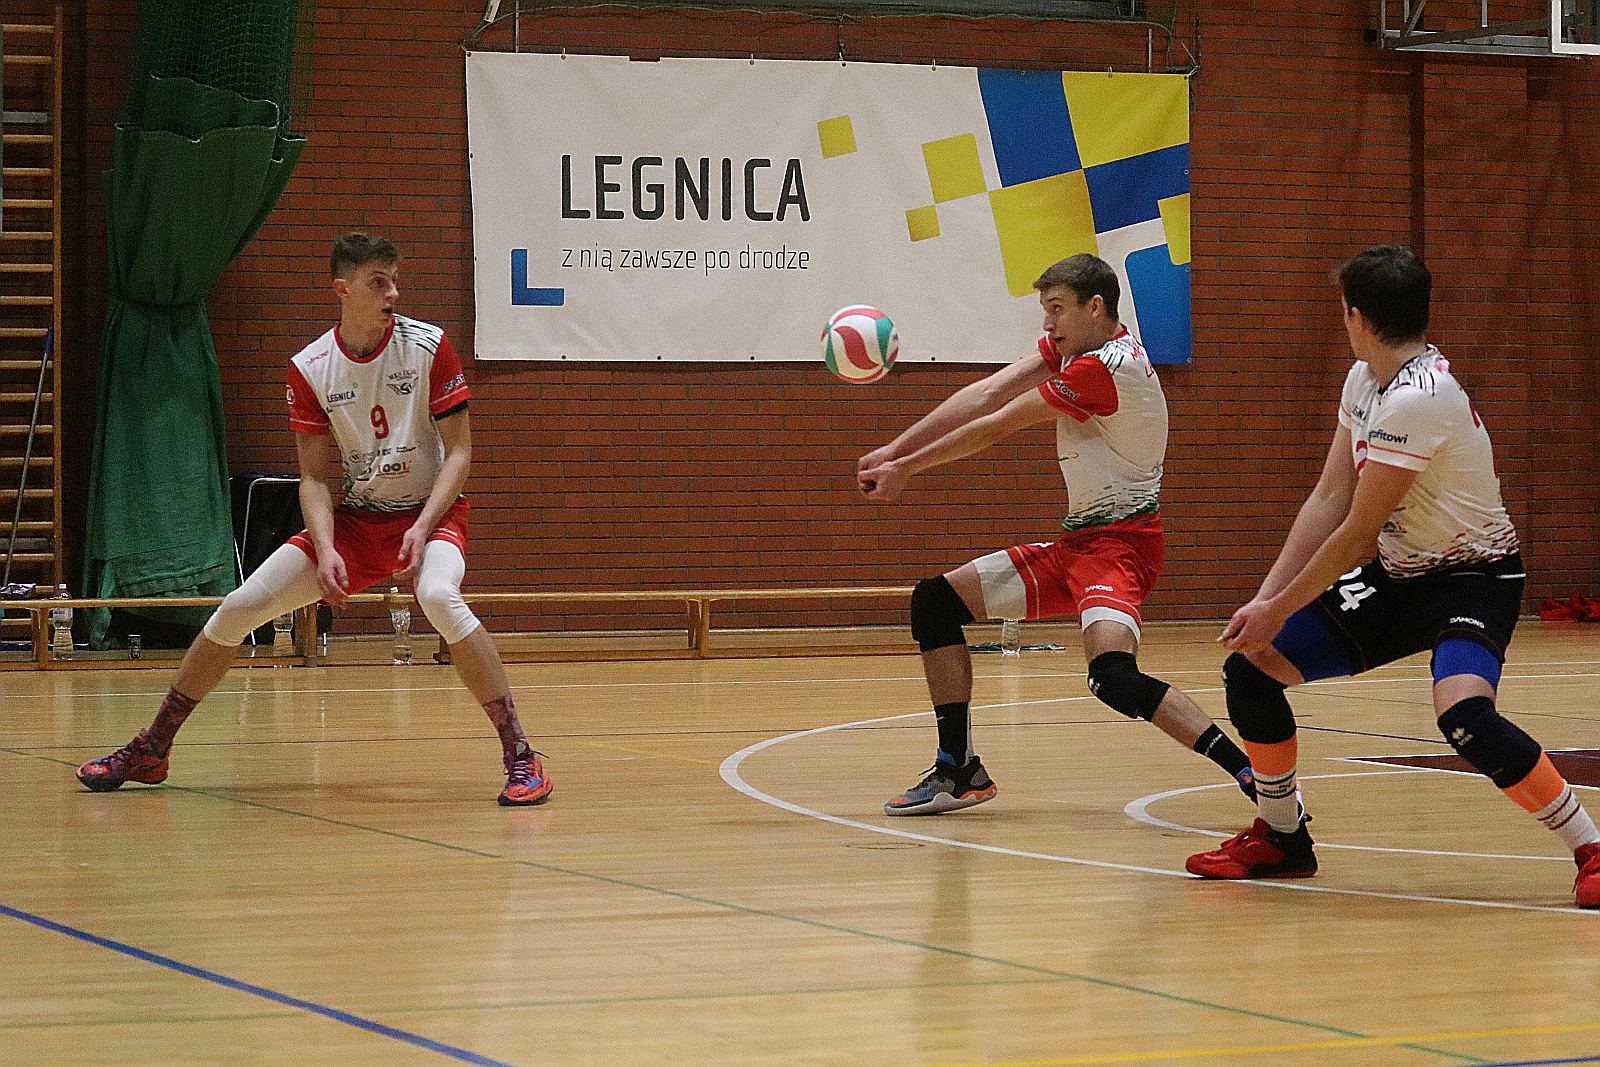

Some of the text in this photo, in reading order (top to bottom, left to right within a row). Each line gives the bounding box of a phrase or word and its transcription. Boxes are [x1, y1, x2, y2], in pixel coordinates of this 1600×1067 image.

[561, 154, 811, 222] LEGNICA
[561, 242, 810, 276] z nią zawsze po drodze
[326, 390, 357, 403] LEGNICA
[370, 404, 390, 440] 9
